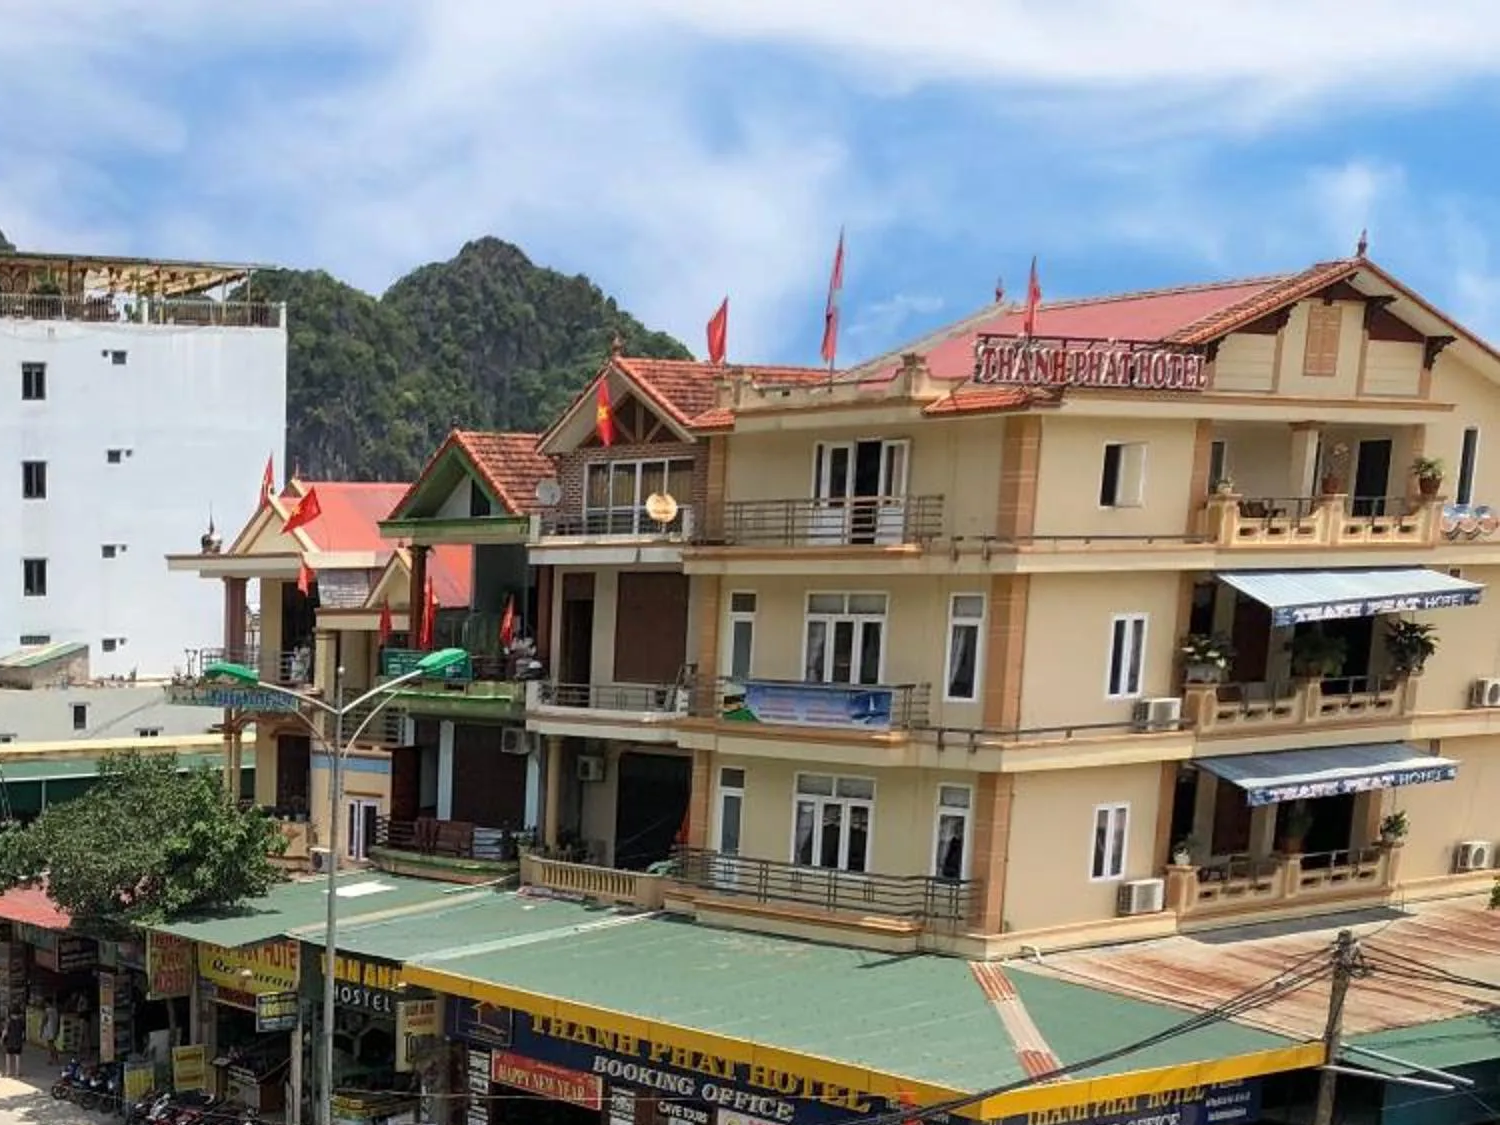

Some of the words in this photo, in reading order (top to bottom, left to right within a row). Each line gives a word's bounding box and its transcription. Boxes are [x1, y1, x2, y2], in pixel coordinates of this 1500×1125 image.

[1134, 350, 1208, 390] HOTEL
[499, 1063, 529, 1086] HAPPY
[557, 1077, 586, 1100] YEAR
[593, 1054, 697, 1097] BOOKING
[701, 1083, 796, 1123] OFFICE
[748, 1062, 872, 1114] HOTEL
